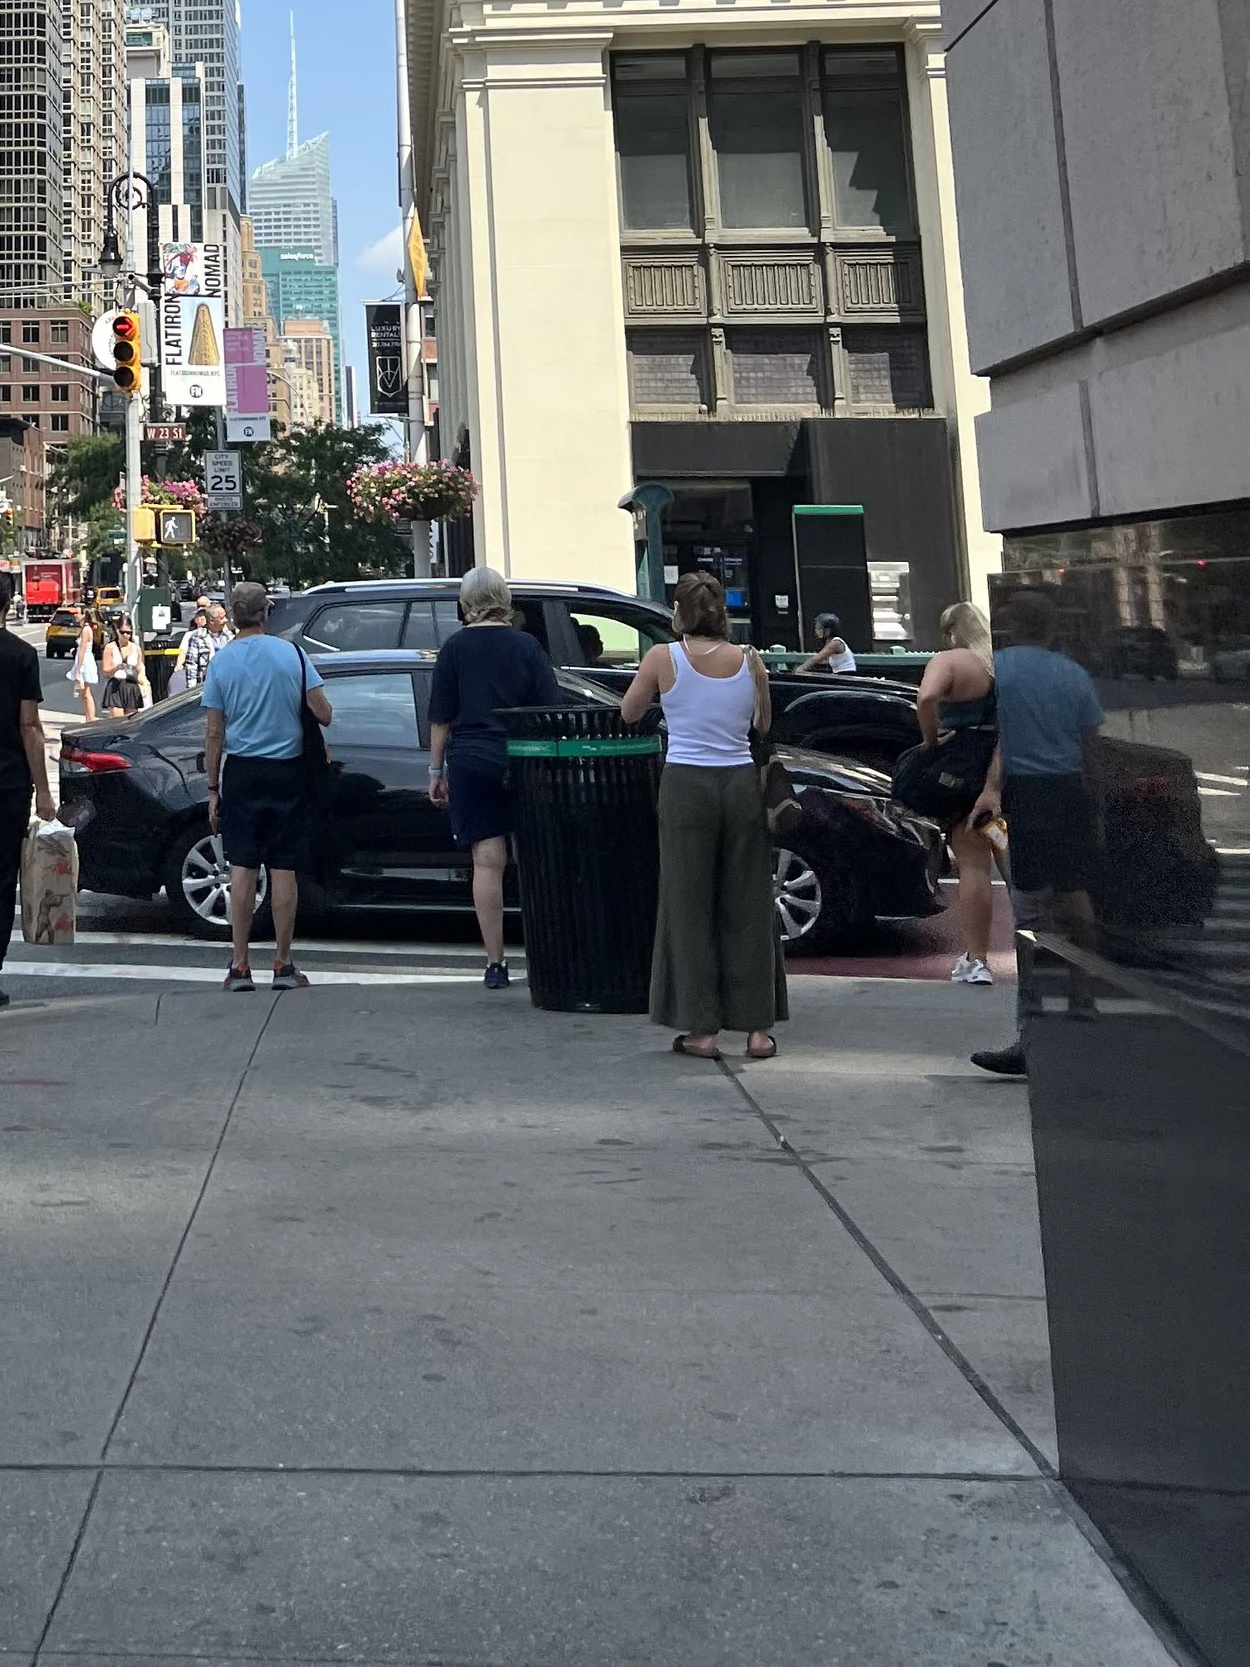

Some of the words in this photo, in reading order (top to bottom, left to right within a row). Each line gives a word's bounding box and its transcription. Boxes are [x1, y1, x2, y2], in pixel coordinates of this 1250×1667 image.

[280, 252, 314, 261] salesforce
[203, 243, 222, 298] NOMAD
[164, 294, 182, 366] FLATIRON
[147, 428, 155, 439] W
[159, 428, 169, 439] 23
[173, 427, 183, 439] St
[211, 475, 237, 491] 25
